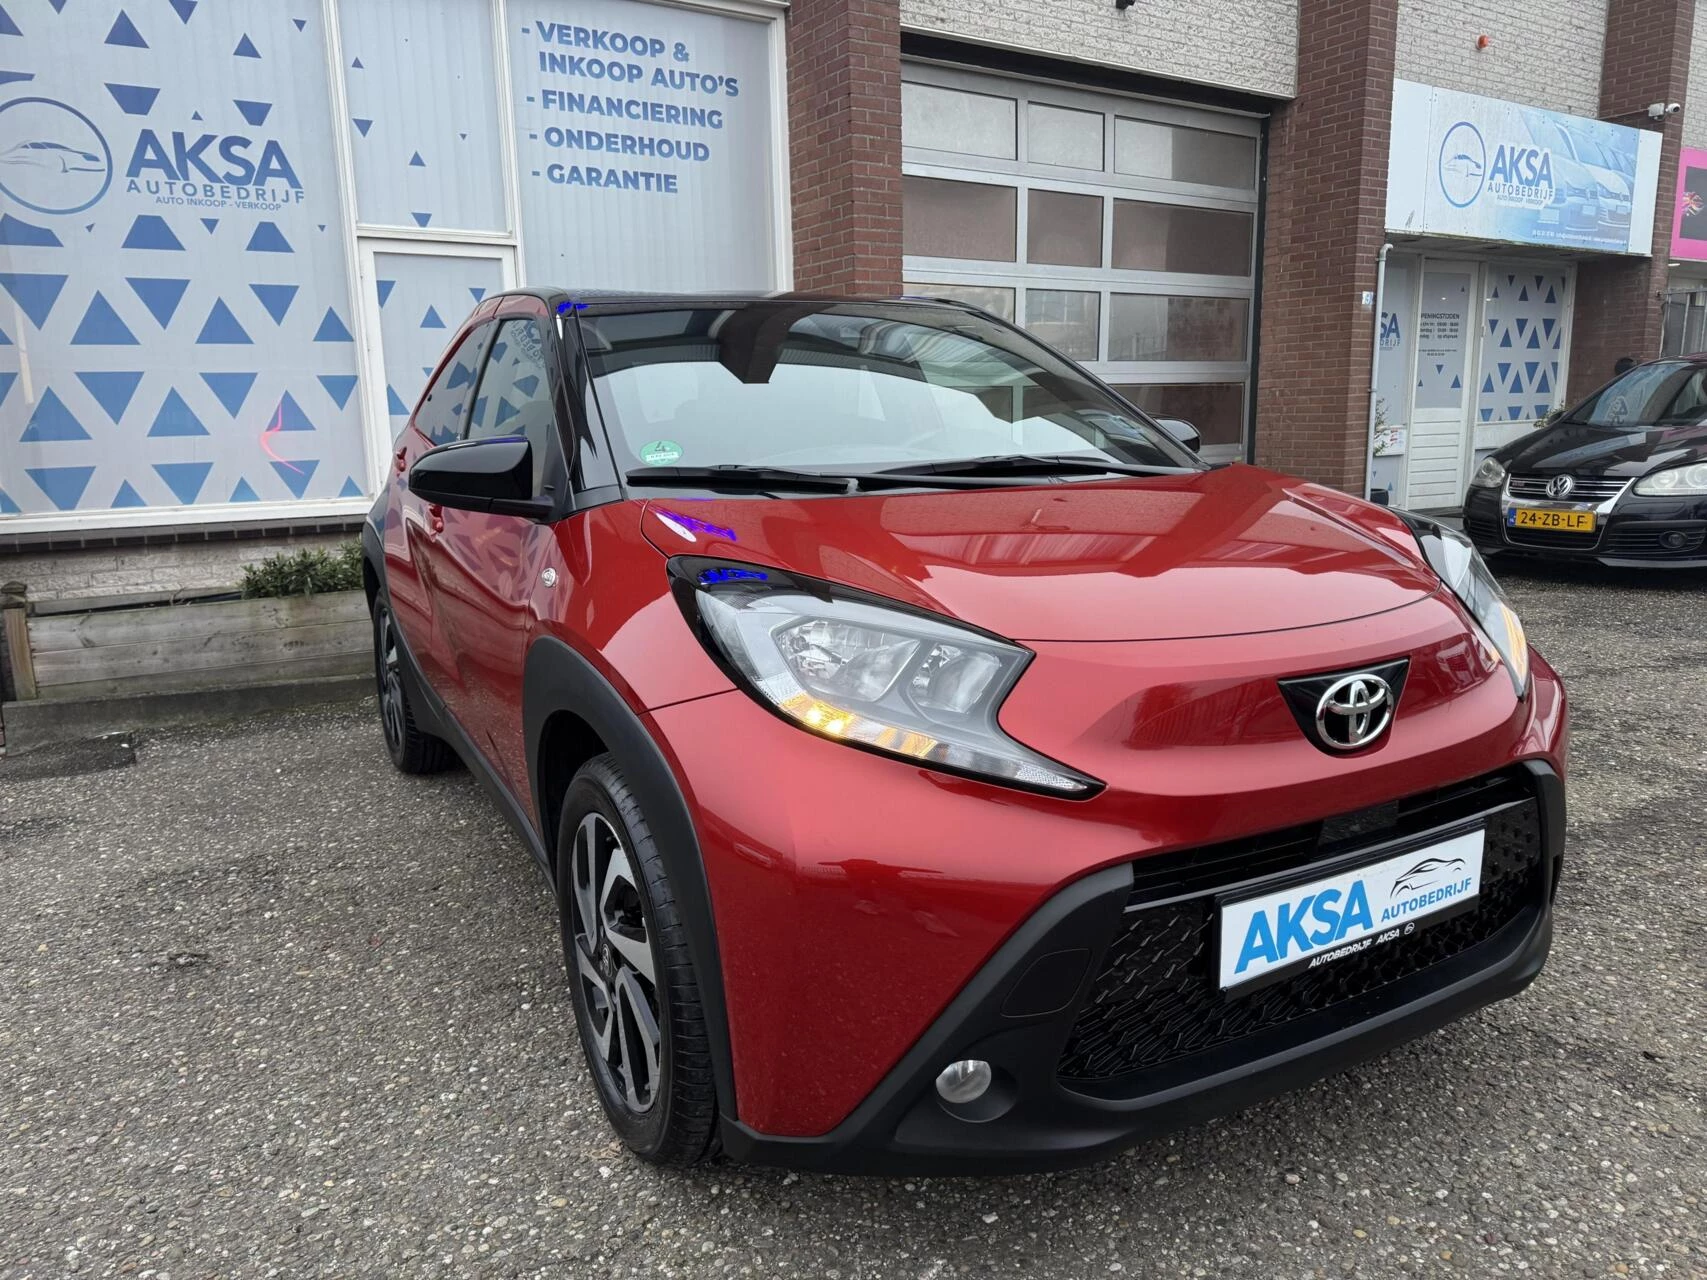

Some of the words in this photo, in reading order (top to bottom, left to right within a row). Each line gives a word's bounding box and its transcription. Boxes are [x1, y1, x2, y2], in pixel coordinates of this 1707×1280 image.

[535, 20, 666, 57] VERKOOP
[673, 42, 690, 62] &
[539, 51, 643, 83] INKOOP
[651, 67, 739, 97] AUTO'S
[541, 88, 723, 129] FINANCIERING
[126, 129, 303, 189] AKSA
[544, 126, 710, 162] ONDERHOUD
[547, 163, 678, 194] GARANTIE
[1489, 144, 1553, 189] AKSA
[126, 179, 304, 204] AUTOBEDRIJF
[156, 196, 184, 205] AUTO
[187, 198, 227, 208] INKOOP
[235, 201, 282, 211] VERKOOP
[1487, 182, 1554, 200] AUTOBEDRIJF
[1380, 312, 1400, 339] SA
[1520, 511, 1586, 528] 24-ZB-LF
[1234, 879, 1374, 974] AKSA
[1380, 877, 1472, 923] AUTOBEDRIJF
[1308, 938, 1373, 969] AUTOBEDRIJF
[1375, 928, 1400, 945] AKSA
